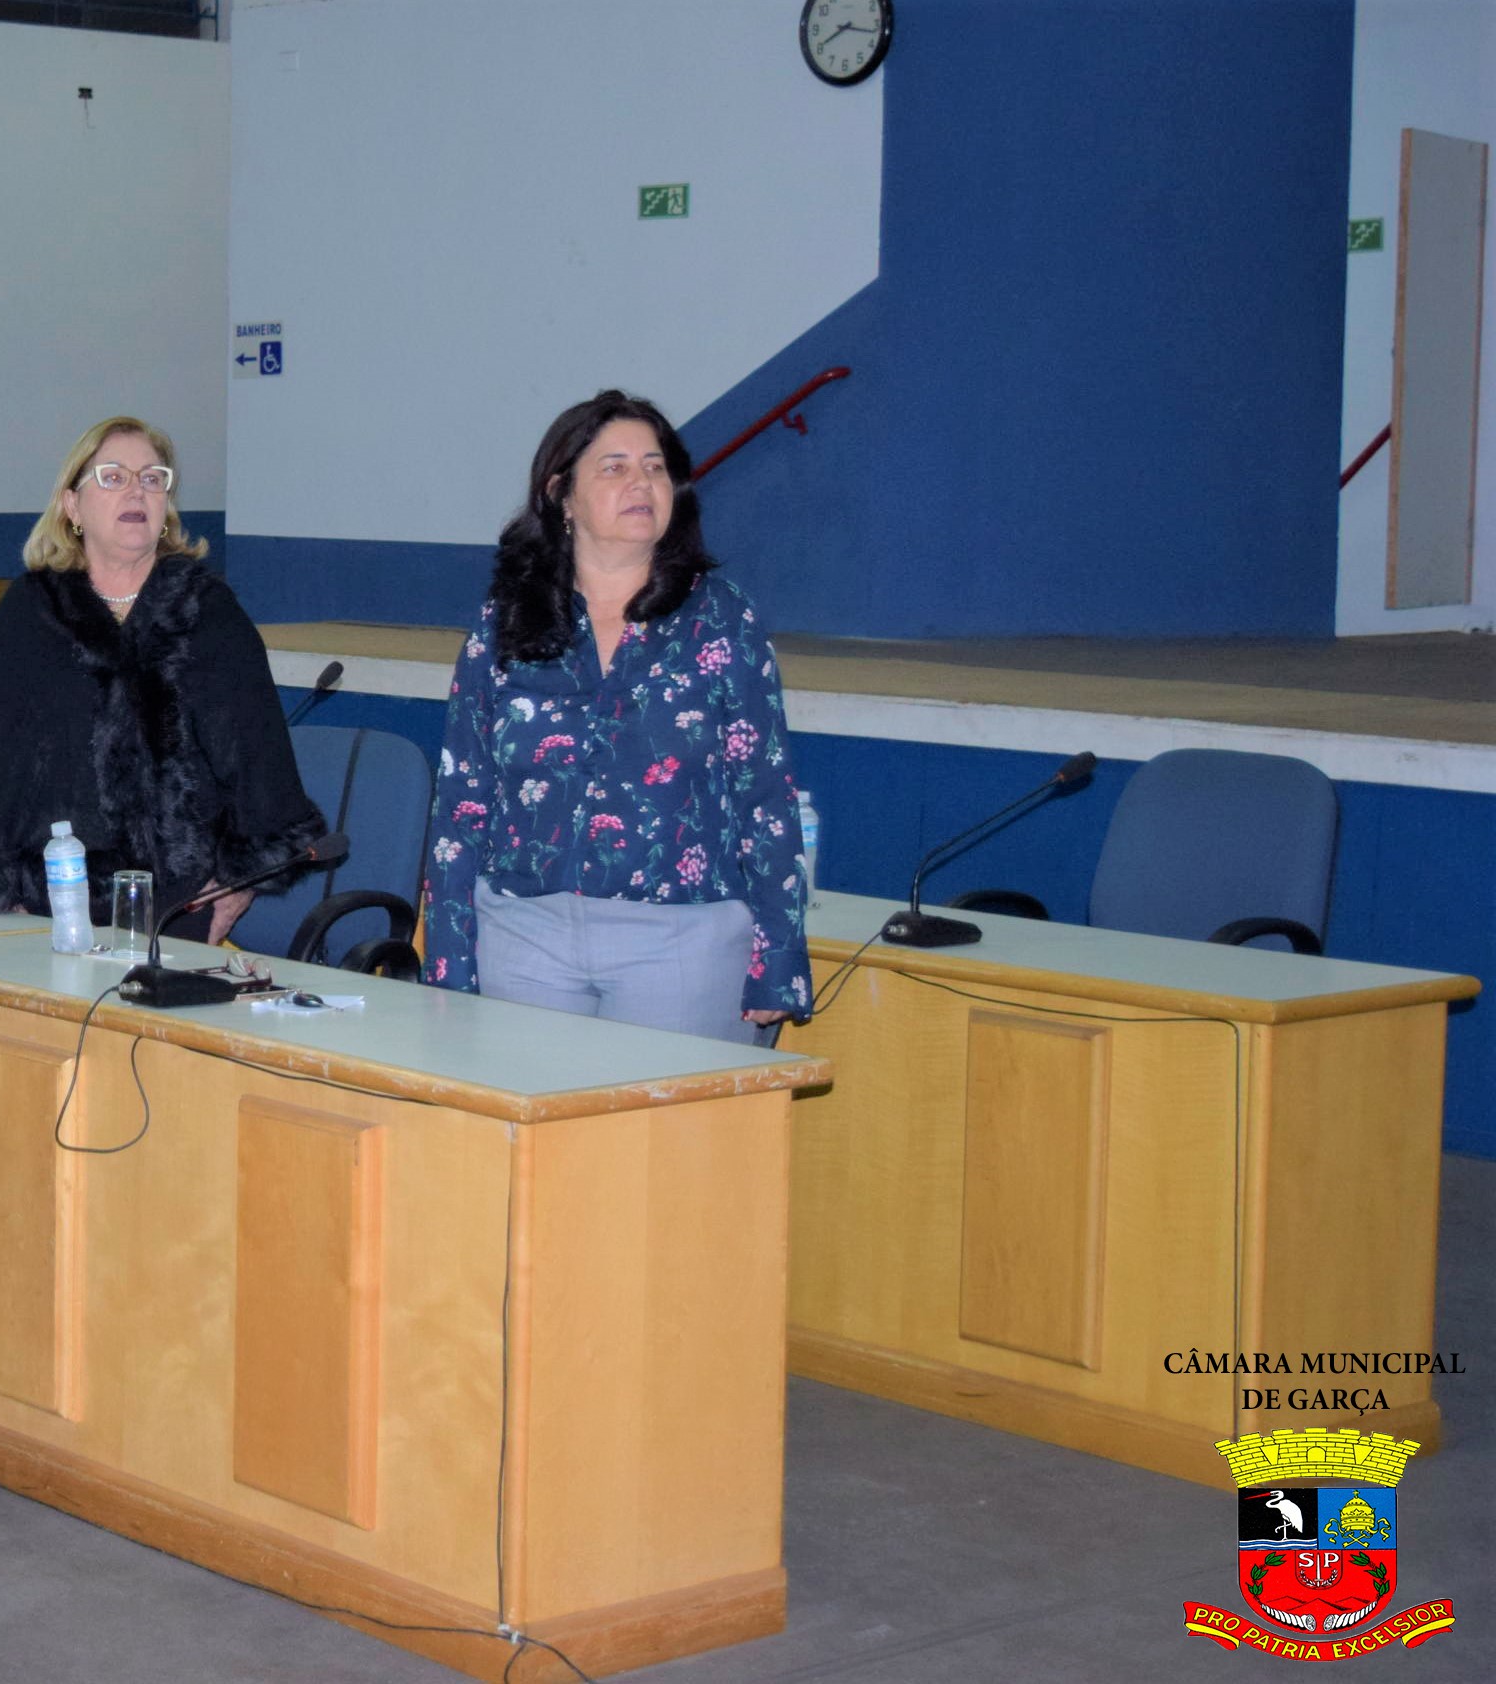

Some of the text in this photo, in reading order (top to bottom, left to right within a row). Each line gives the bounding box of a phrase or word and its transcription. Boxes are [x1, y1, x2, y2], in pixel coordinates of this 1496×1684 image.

[869, 1, 875, 12] 2
[812, 24, 819, 36] 9
[817, 43, 823, 54] 8
[868, 39, 874, 48] 4
[828, 56, 835, 66] 7
[857, 52, 863, 63] 5
[842, 60, 848, 71] 6
[236, 324, 282, 337] BANHEIRO
